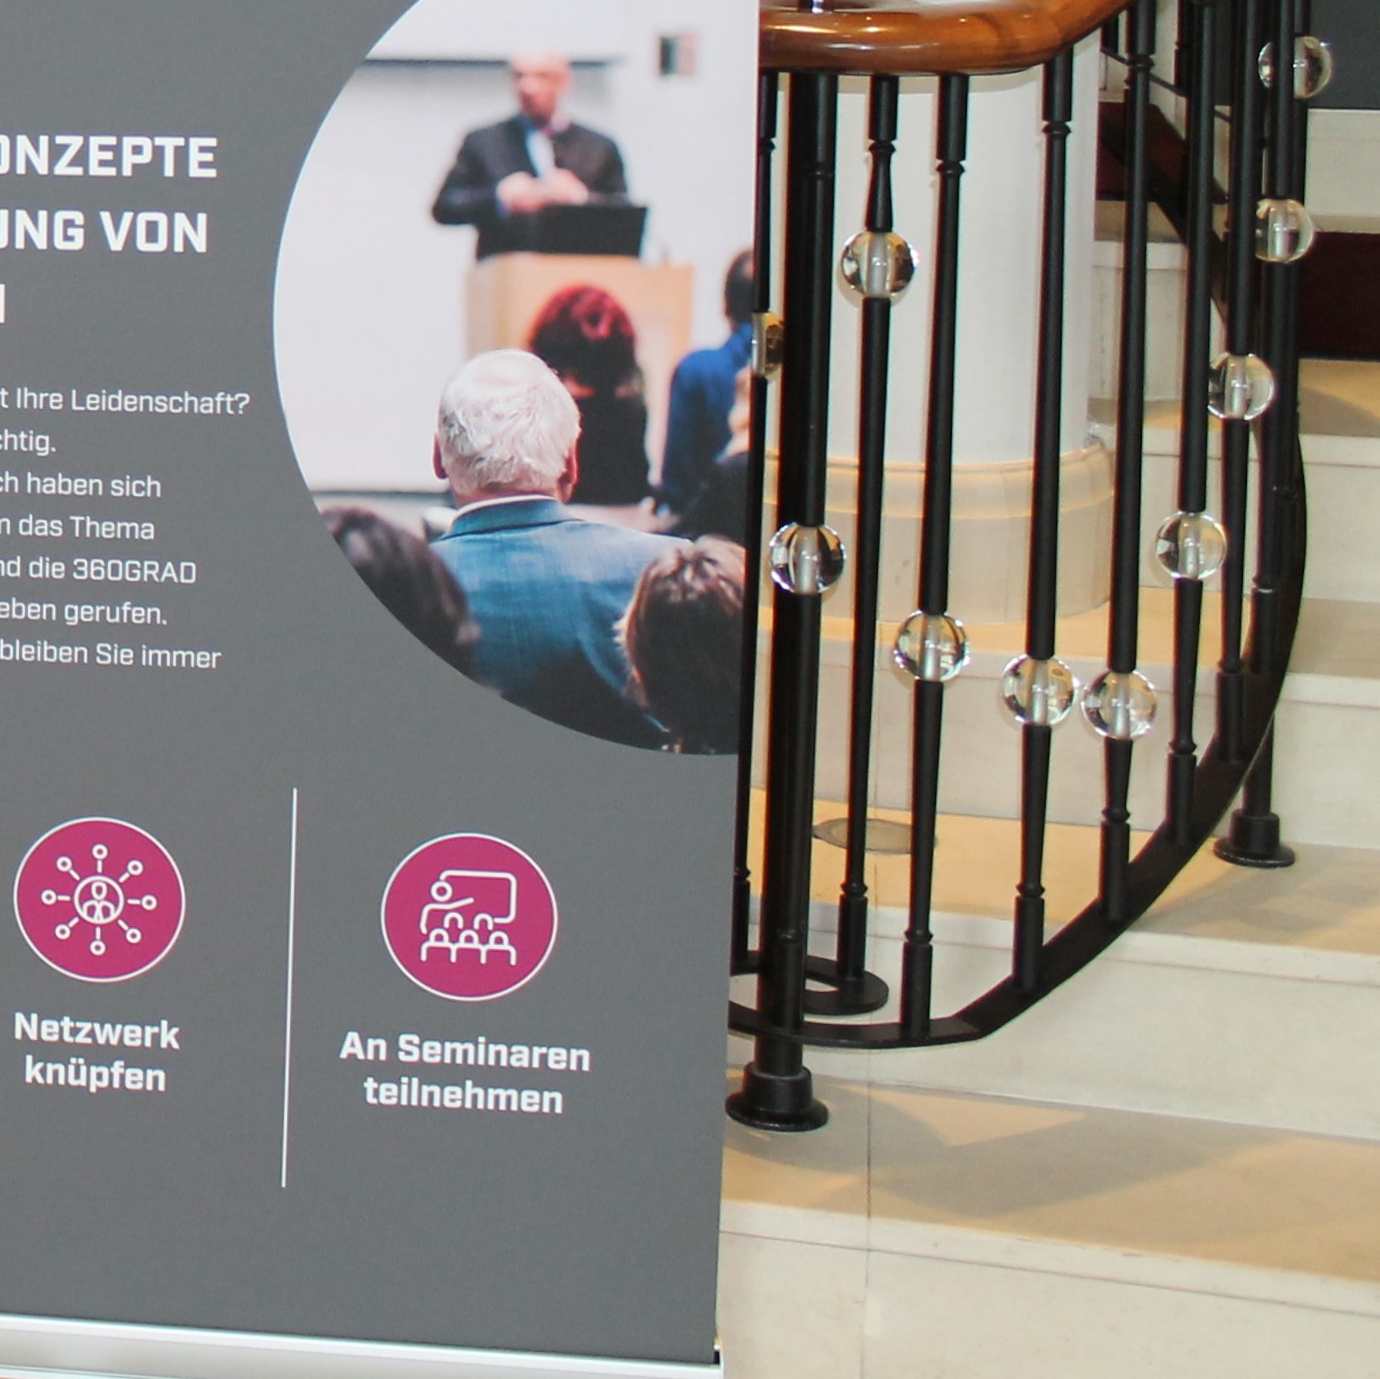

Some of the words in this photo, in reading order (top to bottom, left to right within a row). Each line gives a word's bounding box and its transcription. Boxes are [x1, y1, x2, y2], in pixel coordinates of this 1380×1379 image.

[99, 210, 208, 253] VON
[16, 386, 64, 410] Ihre
[71, 389, 251, 415] Leidenschaft?
[26, 471, 103, 496] haben
[110, 474, 161, 498] sich
[18, 513, 63, 537] das
[69, 515, 155, 540] Thema
[28, 556, 66, 579] die
[72, 558, 197, 584] 360GRAD
[64, 601, 167, 626] gerufen.
[0, 638, 88, 664] bleiben
[95, 642, 134, 666] Sie
[141, 644, 222, 669] immer
[14, 1011, 180, 1050] Netzwerk
[339, 1031, 387, 1061] An
[397, 1033, 590, 1072] Seminaren
[25, 1054, 166, 1093] knüpfen
[363, 1076, 563, 1114] teilnehmen
